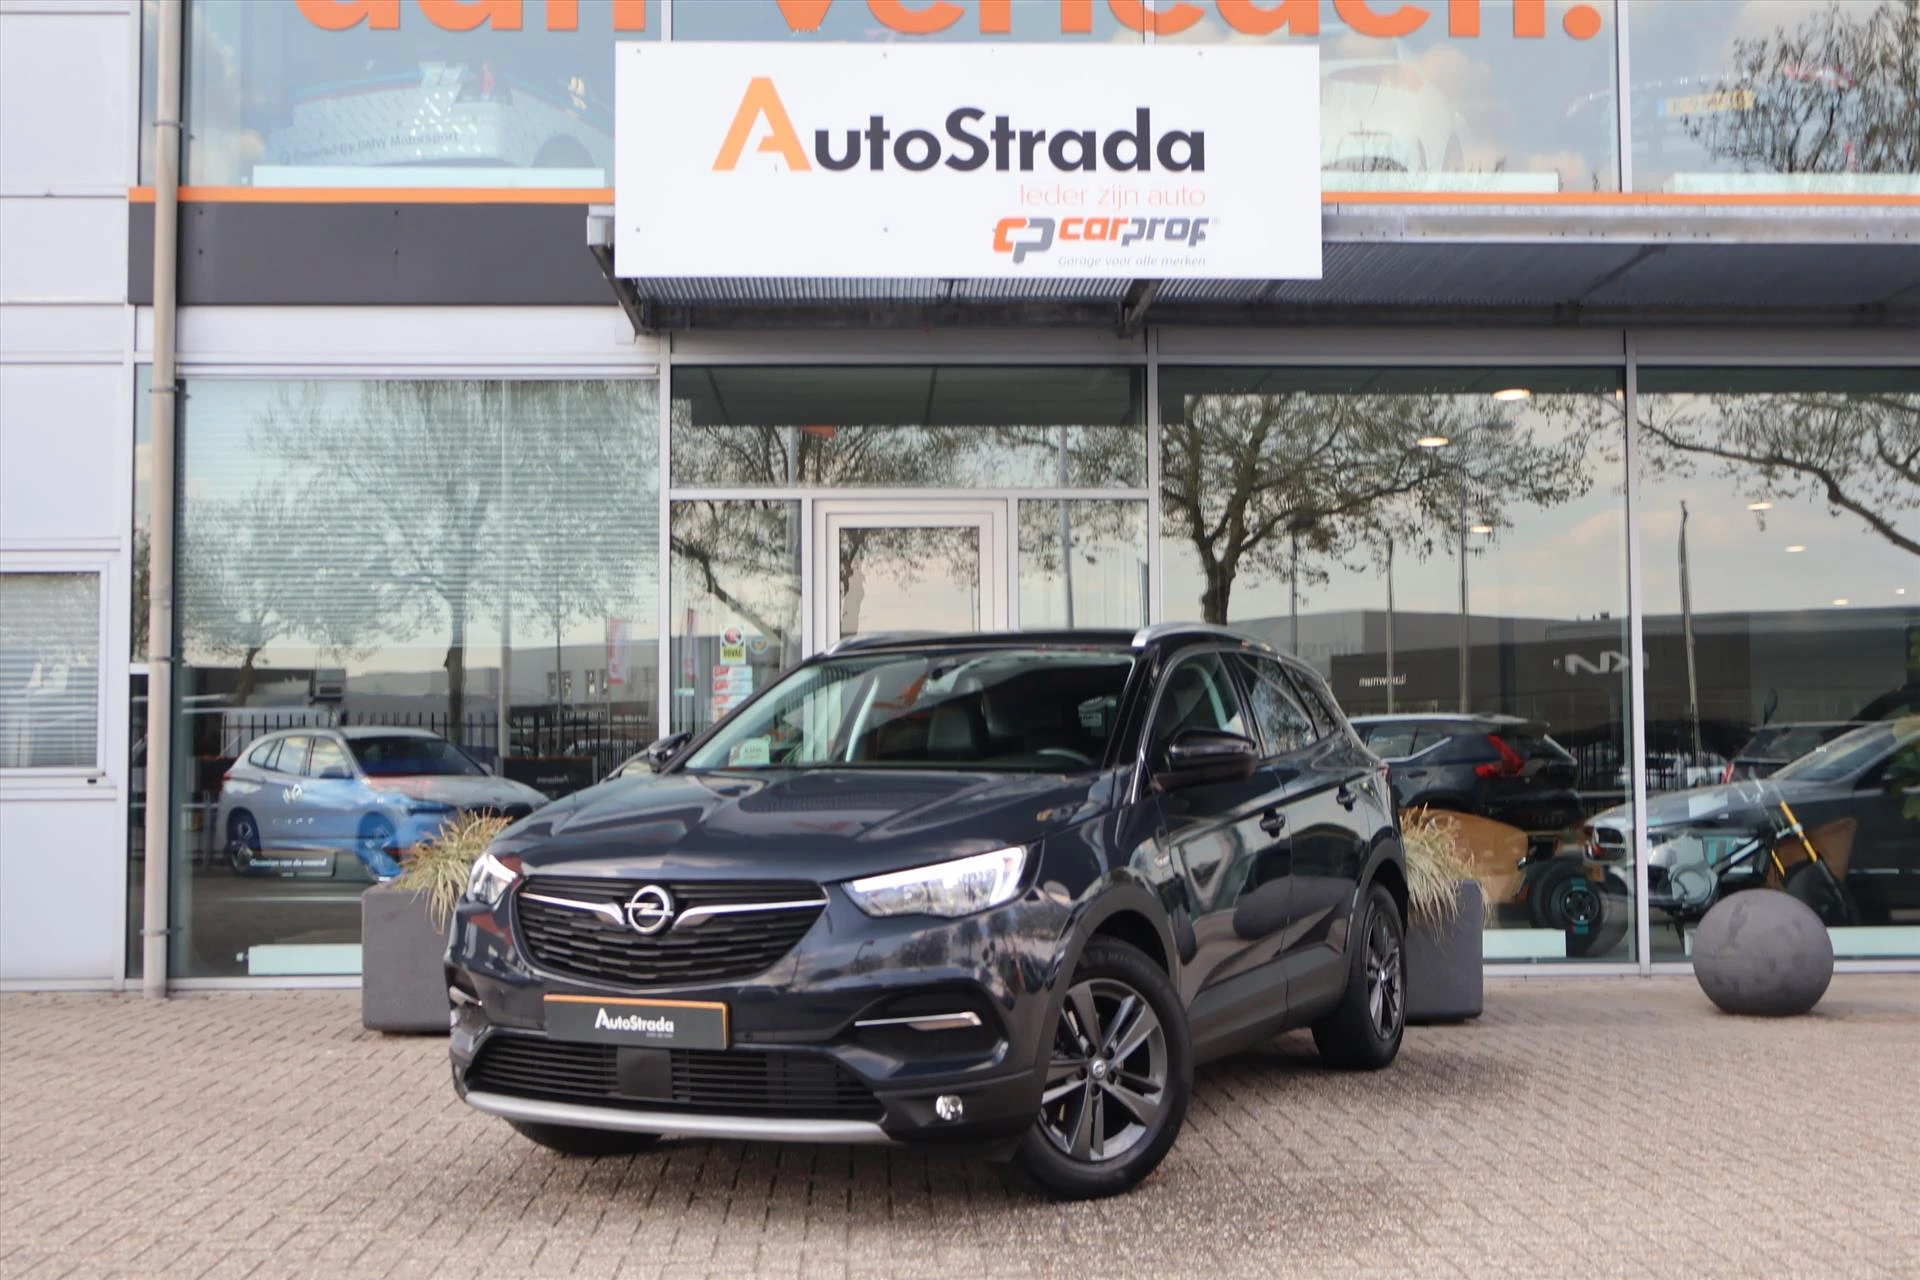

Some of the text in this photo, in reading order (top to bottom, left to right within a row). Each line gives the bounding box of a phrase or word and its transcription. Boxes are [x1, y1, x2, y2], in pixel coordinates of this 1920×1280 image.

[712, 76, 1206, 173] AutoStrada
[389, 130, 459, 149] Motorsport
[1097, 183, 1140, 210] zijn
[1147, 185, 1206, 206] auto
[1058, 217, 1210, 248] carprof
[1057, 255, 1206, 269] Garage voor alle merken
[594, 1007, 675, 1033] AutoStrada
